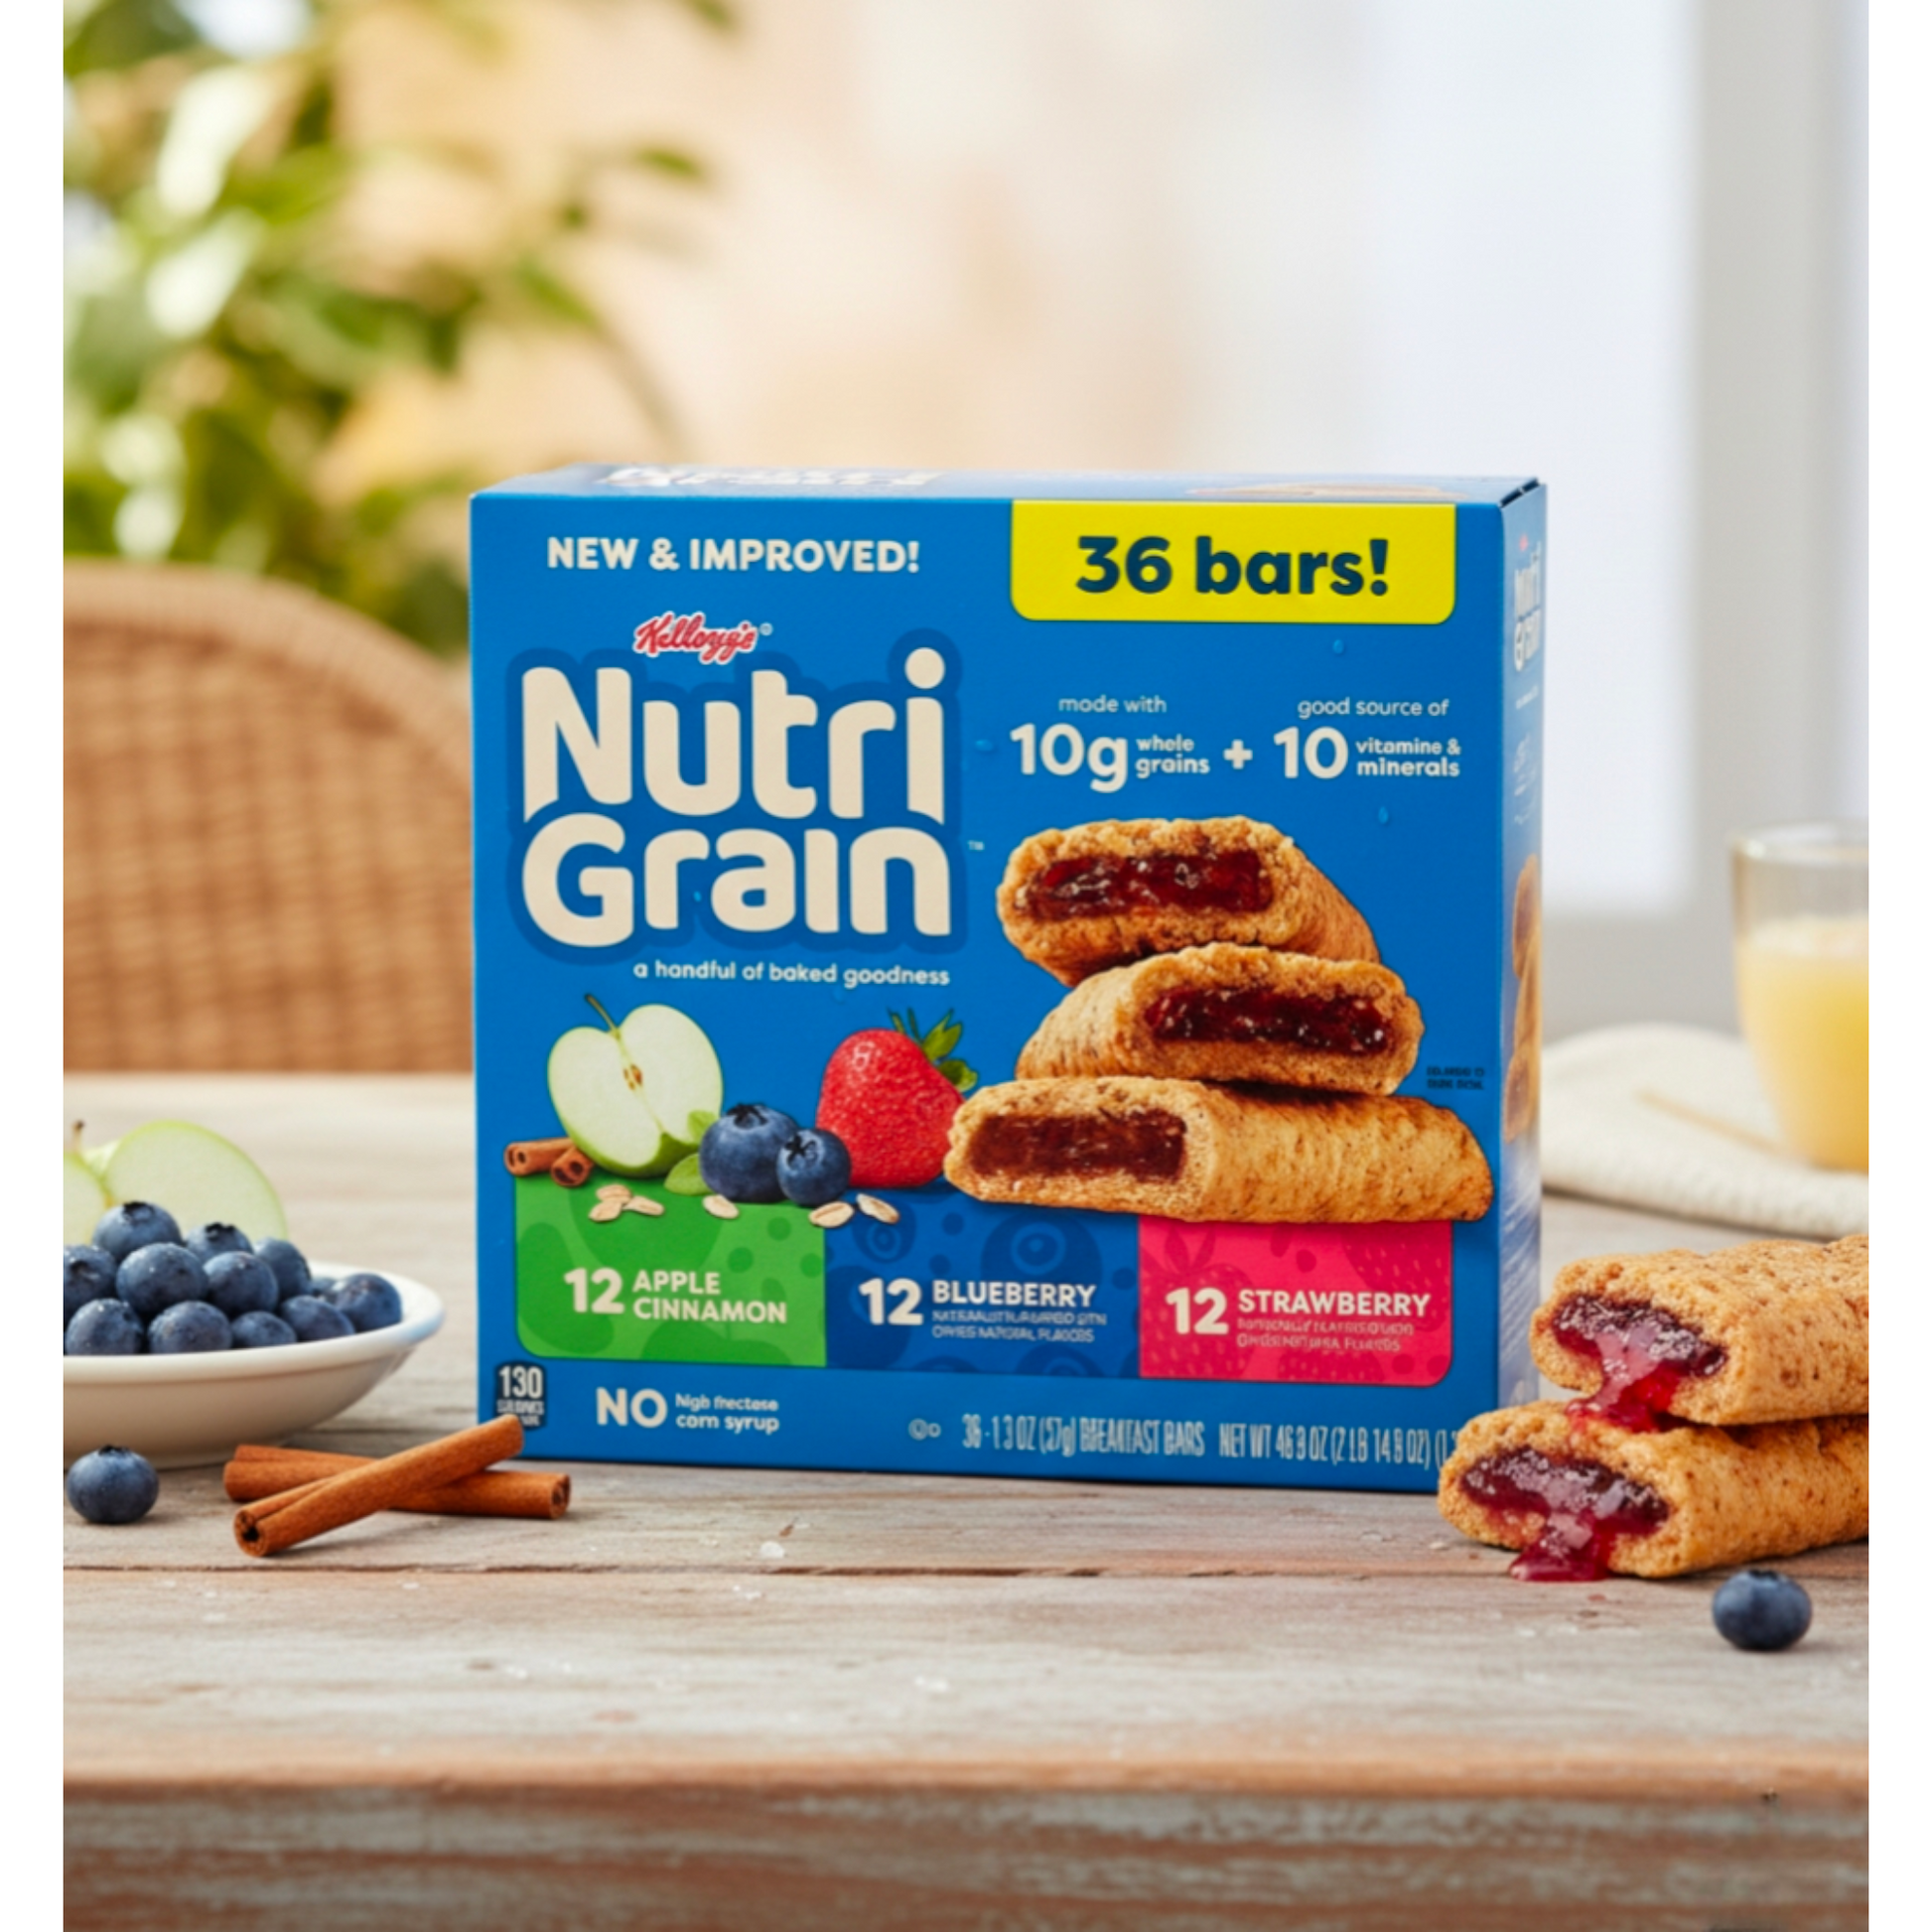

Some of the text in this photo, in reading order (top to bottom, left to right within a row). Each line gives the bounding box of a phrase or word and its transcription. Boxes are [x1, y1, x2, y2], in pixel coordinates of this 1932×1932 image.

[548, 537, 918, 573] NEW & IMPROVED!
[1076, 536, 1388, 596] 36 bars!
[1124, 696, 1167, 712] with
[1298, 698, 1449, 720] good source of
[522, 647, 944, 825] Nutri
[1137, 735, 1194, 752] whole
[1447, 739, 1460, 755] &
[1011, 724, 1128, 793] 10g
[1136, 755, 1209, 778] grains
[1274, 727, 1348, 778] 10
[1357, 757, 1459, 776] minerals
[522, 813, 950, 947] Grain
[633, 960, 950, 989] a handful of baked goodness
[564, 1267, 624, 1313] 12
[632, 1270, 721, 1295] APPLE
[933, 1280, 1095, 1307] BLUEBERRY
[633, 1298, 786, 1323] CINNAMON
[860, 1279, 922, 1325] 12
[1166, 1288, 1228, 1334] 12
[1239, 1289, 1431, 1316] STRAWBERRY
[499, 1366, 542, 1399] 130
[597, 1388, 667, 1428] NO
[725, 1415, 779, 1435] syrup
[1219, 1424, 1246, 1457] NET
